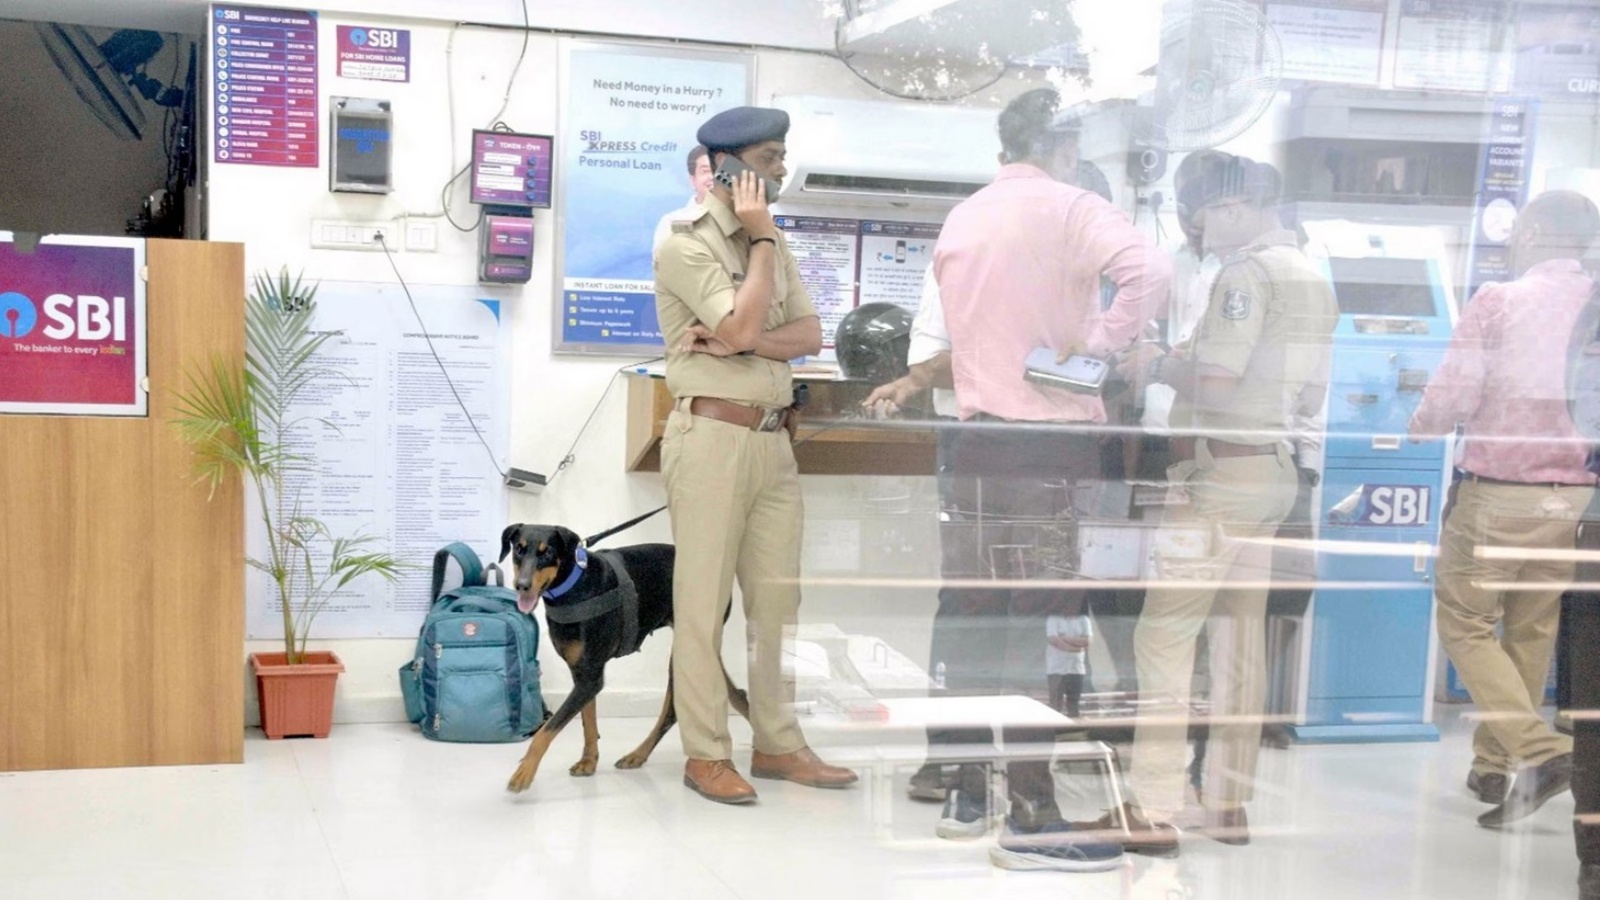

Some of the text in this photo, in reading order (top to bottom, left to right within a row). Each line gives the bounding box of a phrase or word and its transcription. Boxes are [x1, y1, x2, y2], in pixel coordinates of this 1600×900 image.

[224, 10, 240, 20] SBI
[368, 29, 397, 48] SBI
[593, 79, 723, 98] Need Money in a Hurry ?
[1568, 78, 1600, 92] CUR
[610, 97, 706, 114] No need to worry!
[1502, 105, 1519, 117] SBI
[580, 130, 601, 141] SBI
[587, 141, 677, 151] XPRESS Credit
[1490, 147, 1526, 155] ACCOUNT
[579, 156, 662, 170] Personal Loan
[43, 294, 126, 341] SBI
[14, 343, 31, 352] The
[32, 344, 62, 353] banker
[63, 345, 73, 353] to
[74, 347, 98, 356] every
[1369, 487, 1429, 524] SBI
